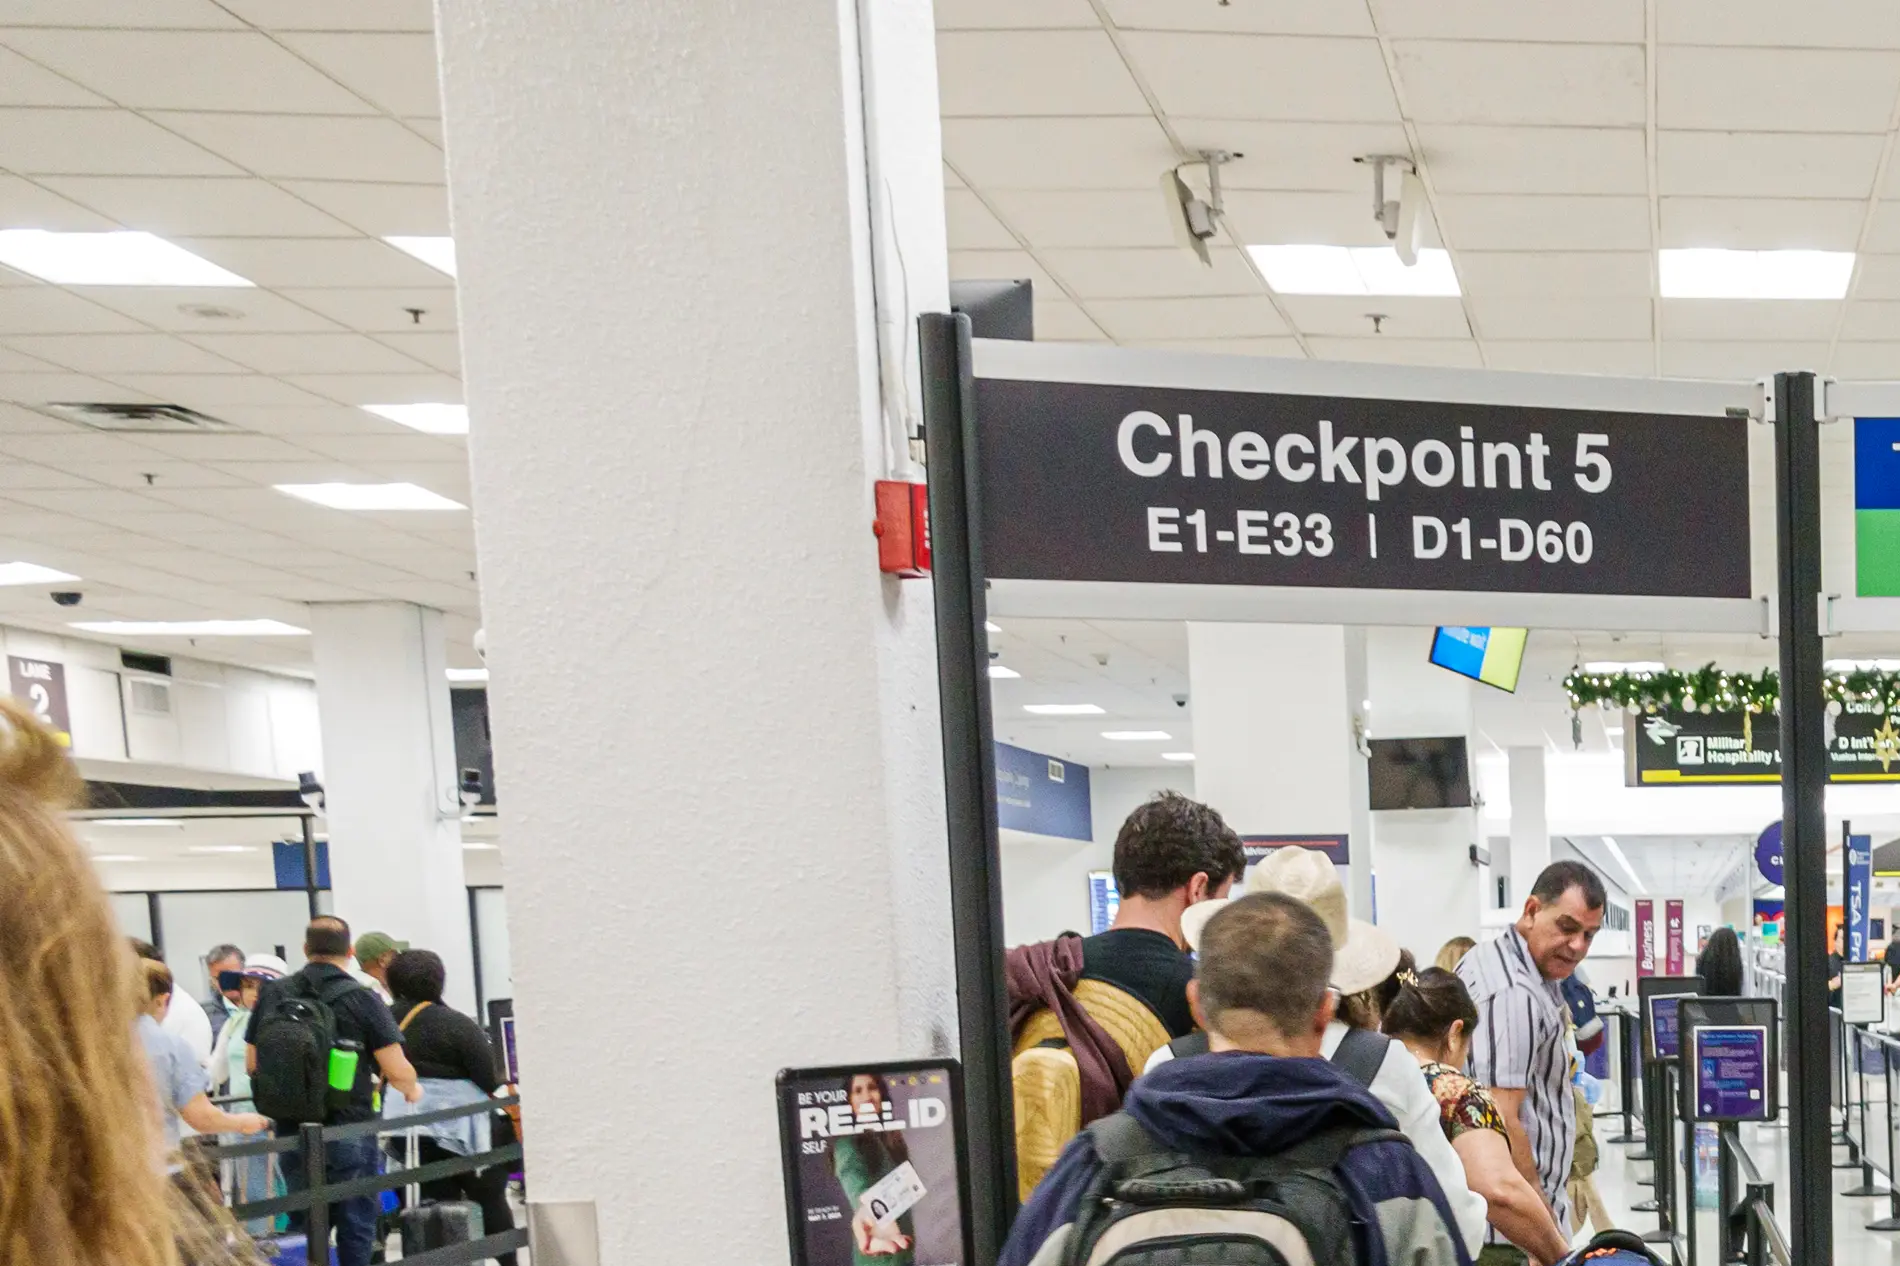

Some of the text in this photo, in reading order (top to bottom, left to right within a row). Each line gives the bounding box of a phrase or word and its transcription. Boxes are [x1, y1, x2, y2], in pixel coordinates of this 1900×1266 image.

[1116, 410, 1613, 500] Checkpoint 5
[1146, 506, 1335, 557] E1-E33
[1411, 514, 1595, 564] D1-D60
[1706, 736, 1751, 750] Militar
[1850, 880, 1862, 926] TSA
[798, 1089, 848, 1106] BE YOUR
[799, 1097, 946, 1139] REAL ID
[802, 1140, 828, 1155] SELF
